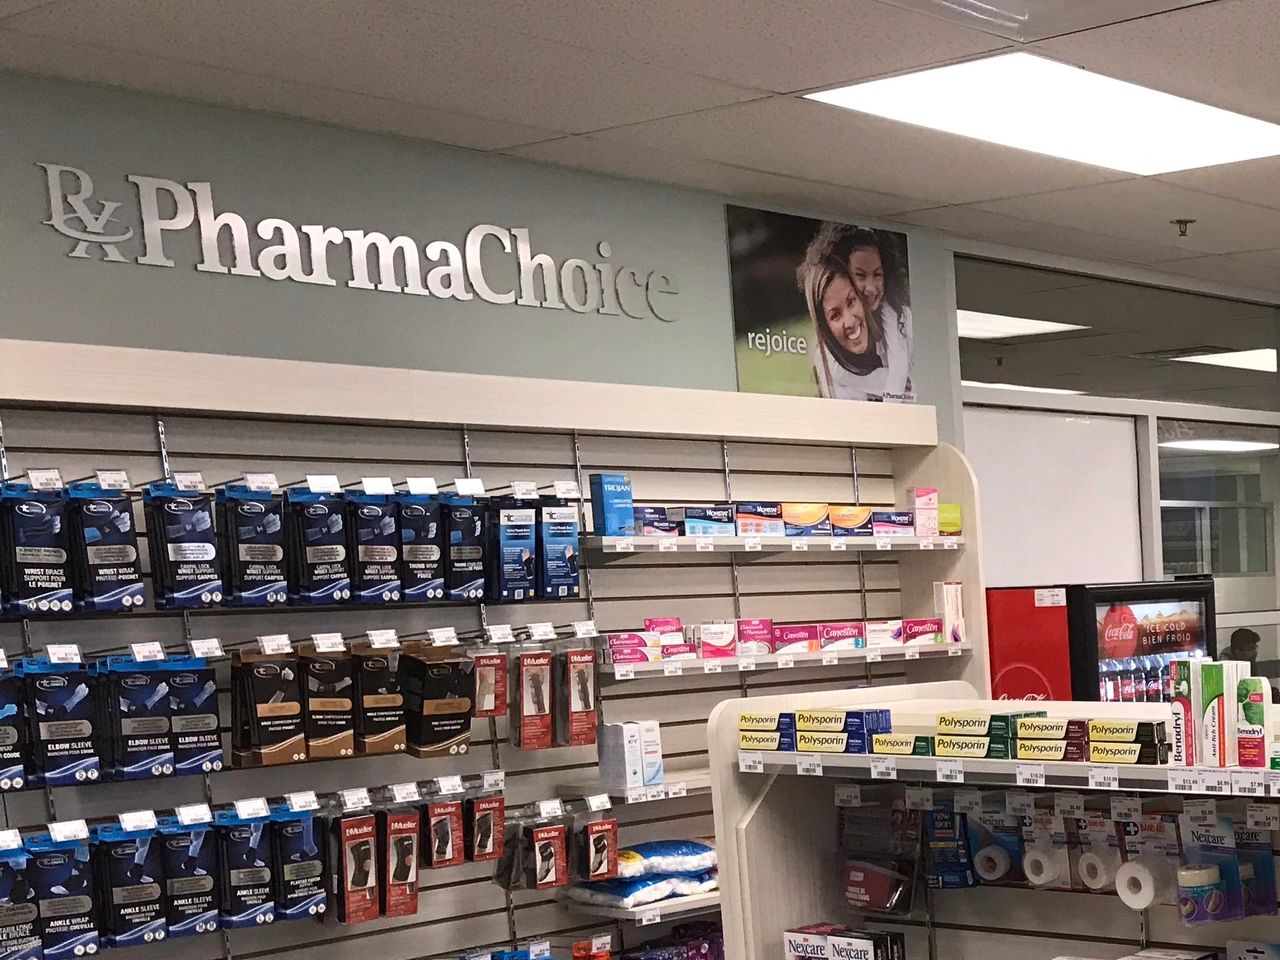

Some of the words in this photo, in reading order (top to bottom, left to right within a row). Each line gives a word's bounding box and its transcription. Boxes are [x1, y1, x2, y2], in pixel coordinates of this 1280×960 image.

[127, 173, 682, 324] PharmaChoice
[747, 328, 807, 357] rejoice
[604, 484, 631, 492] TROJAN
[24, 568, 44, 576] WRIST
[98, 567, 117, 575] WRIST
[824, 626, 858, 639] Canesten
[906, 623, 938, 633] Canesten
[1165, 623, 1186, 631] COLD
[1143, 636, 1162, 645] BIEN
[1166, 633, 1191, 642] FROID
[526, 657, 549, 666] Mueller
[573, 654, 592, 663] Mueller
[740, 714, 776, 726] Polysporin
[798, 713, 842, 728] Polysporin
[939, 716, 987, 731] Polysporin
[1019, 721, 1064, 734] Polysporin
[1091, 725, 1134, 737] Polysporin
[1237, 728, 1263, 738] Benadryl
[128, 739, 148, 747] ELBOW
[149, 737, 169, 745] SLEEVE
[178, 736, 198, 744] ELBOW
[199, 734, 218, 742] SLEEVE
[740, 734, 777, 745] Polysporin
[799, 733, 844, 748] Polysporin
[1174, 711, 1182, 762] Benadryl
[48, 742, 70, 750] ELBOW
[71, 741, 92, 749] SLEEVE
[874, 737, 912, 749] Polysporin
[937, 738, 985, 752] Polysporin
[1019, 743, 1062, 755] Polysporin
[1092, 746, 1136, 758] Polysporin
[350, 825, 373, 836] Mueller
[394, 820, 416, 831] Mueller
[1192, 830, 1225, 846] Nexcare
[1234, 830, 1260, 842] excare
[253, 887, 270, 895] SLEEVE
[174, 898, 192, 906] ANKLE
[193, 895, 212, 904] SLEEVE
[120, 907, 138, 915] ANKLE
[139, 904, 160, 913] SLEEVE
[50, 918, 71, 927] ANKLE
[71, 917, 90, 925] WRAP
[788, 939, 825, 957] Nexcare
[832, 943, 869, 960] Nexcare
